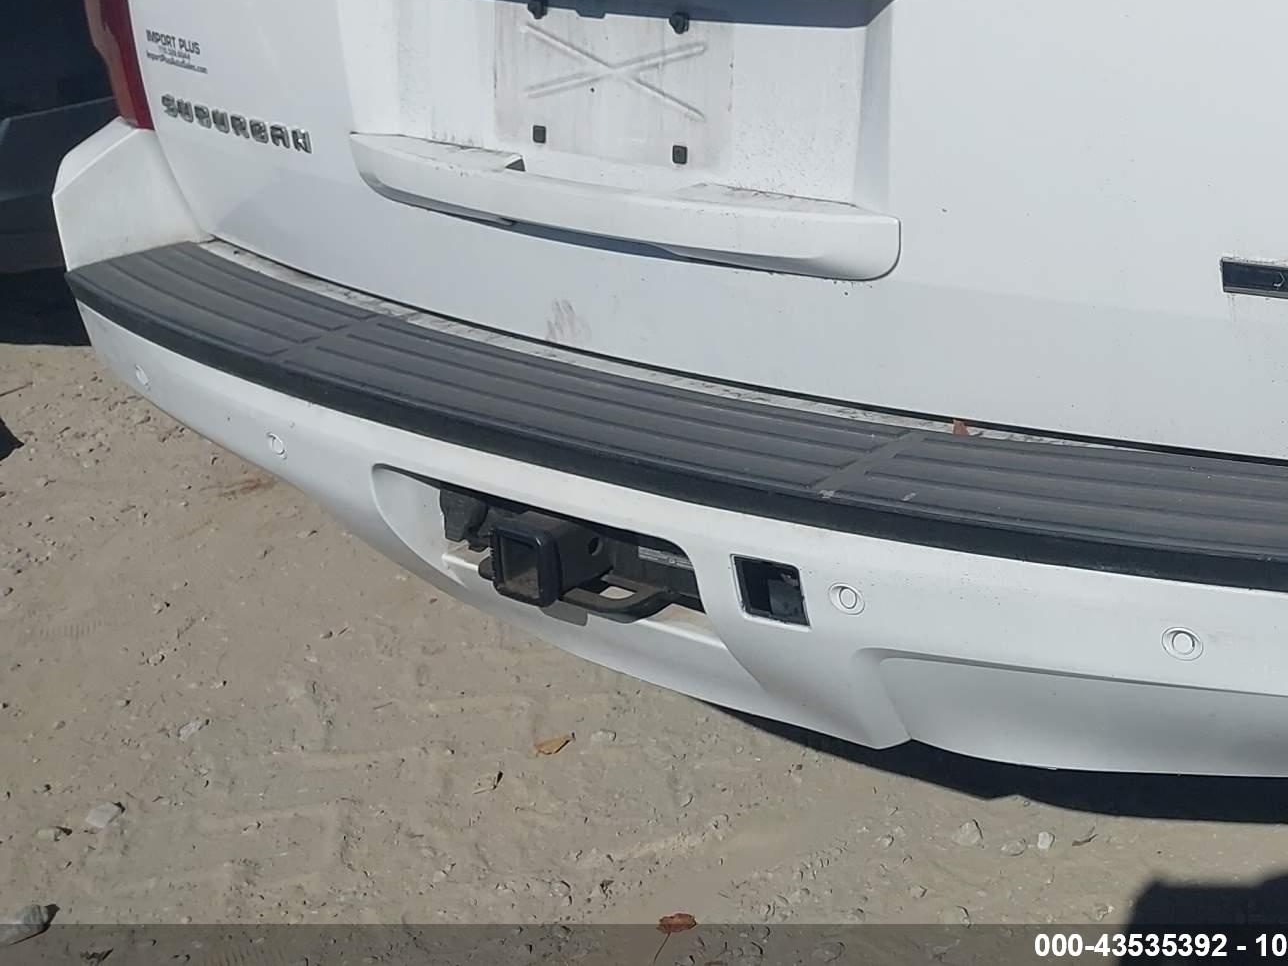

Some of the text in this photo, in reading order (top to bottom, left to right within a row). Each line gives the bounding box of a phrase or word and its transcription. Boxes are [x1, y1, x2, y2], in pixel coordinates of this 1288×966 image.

[146, 29, 176, 49] IMPORT
[178, 37, 201, 55] PLUS
[161, 93, 312, 153] SUBURBAN
